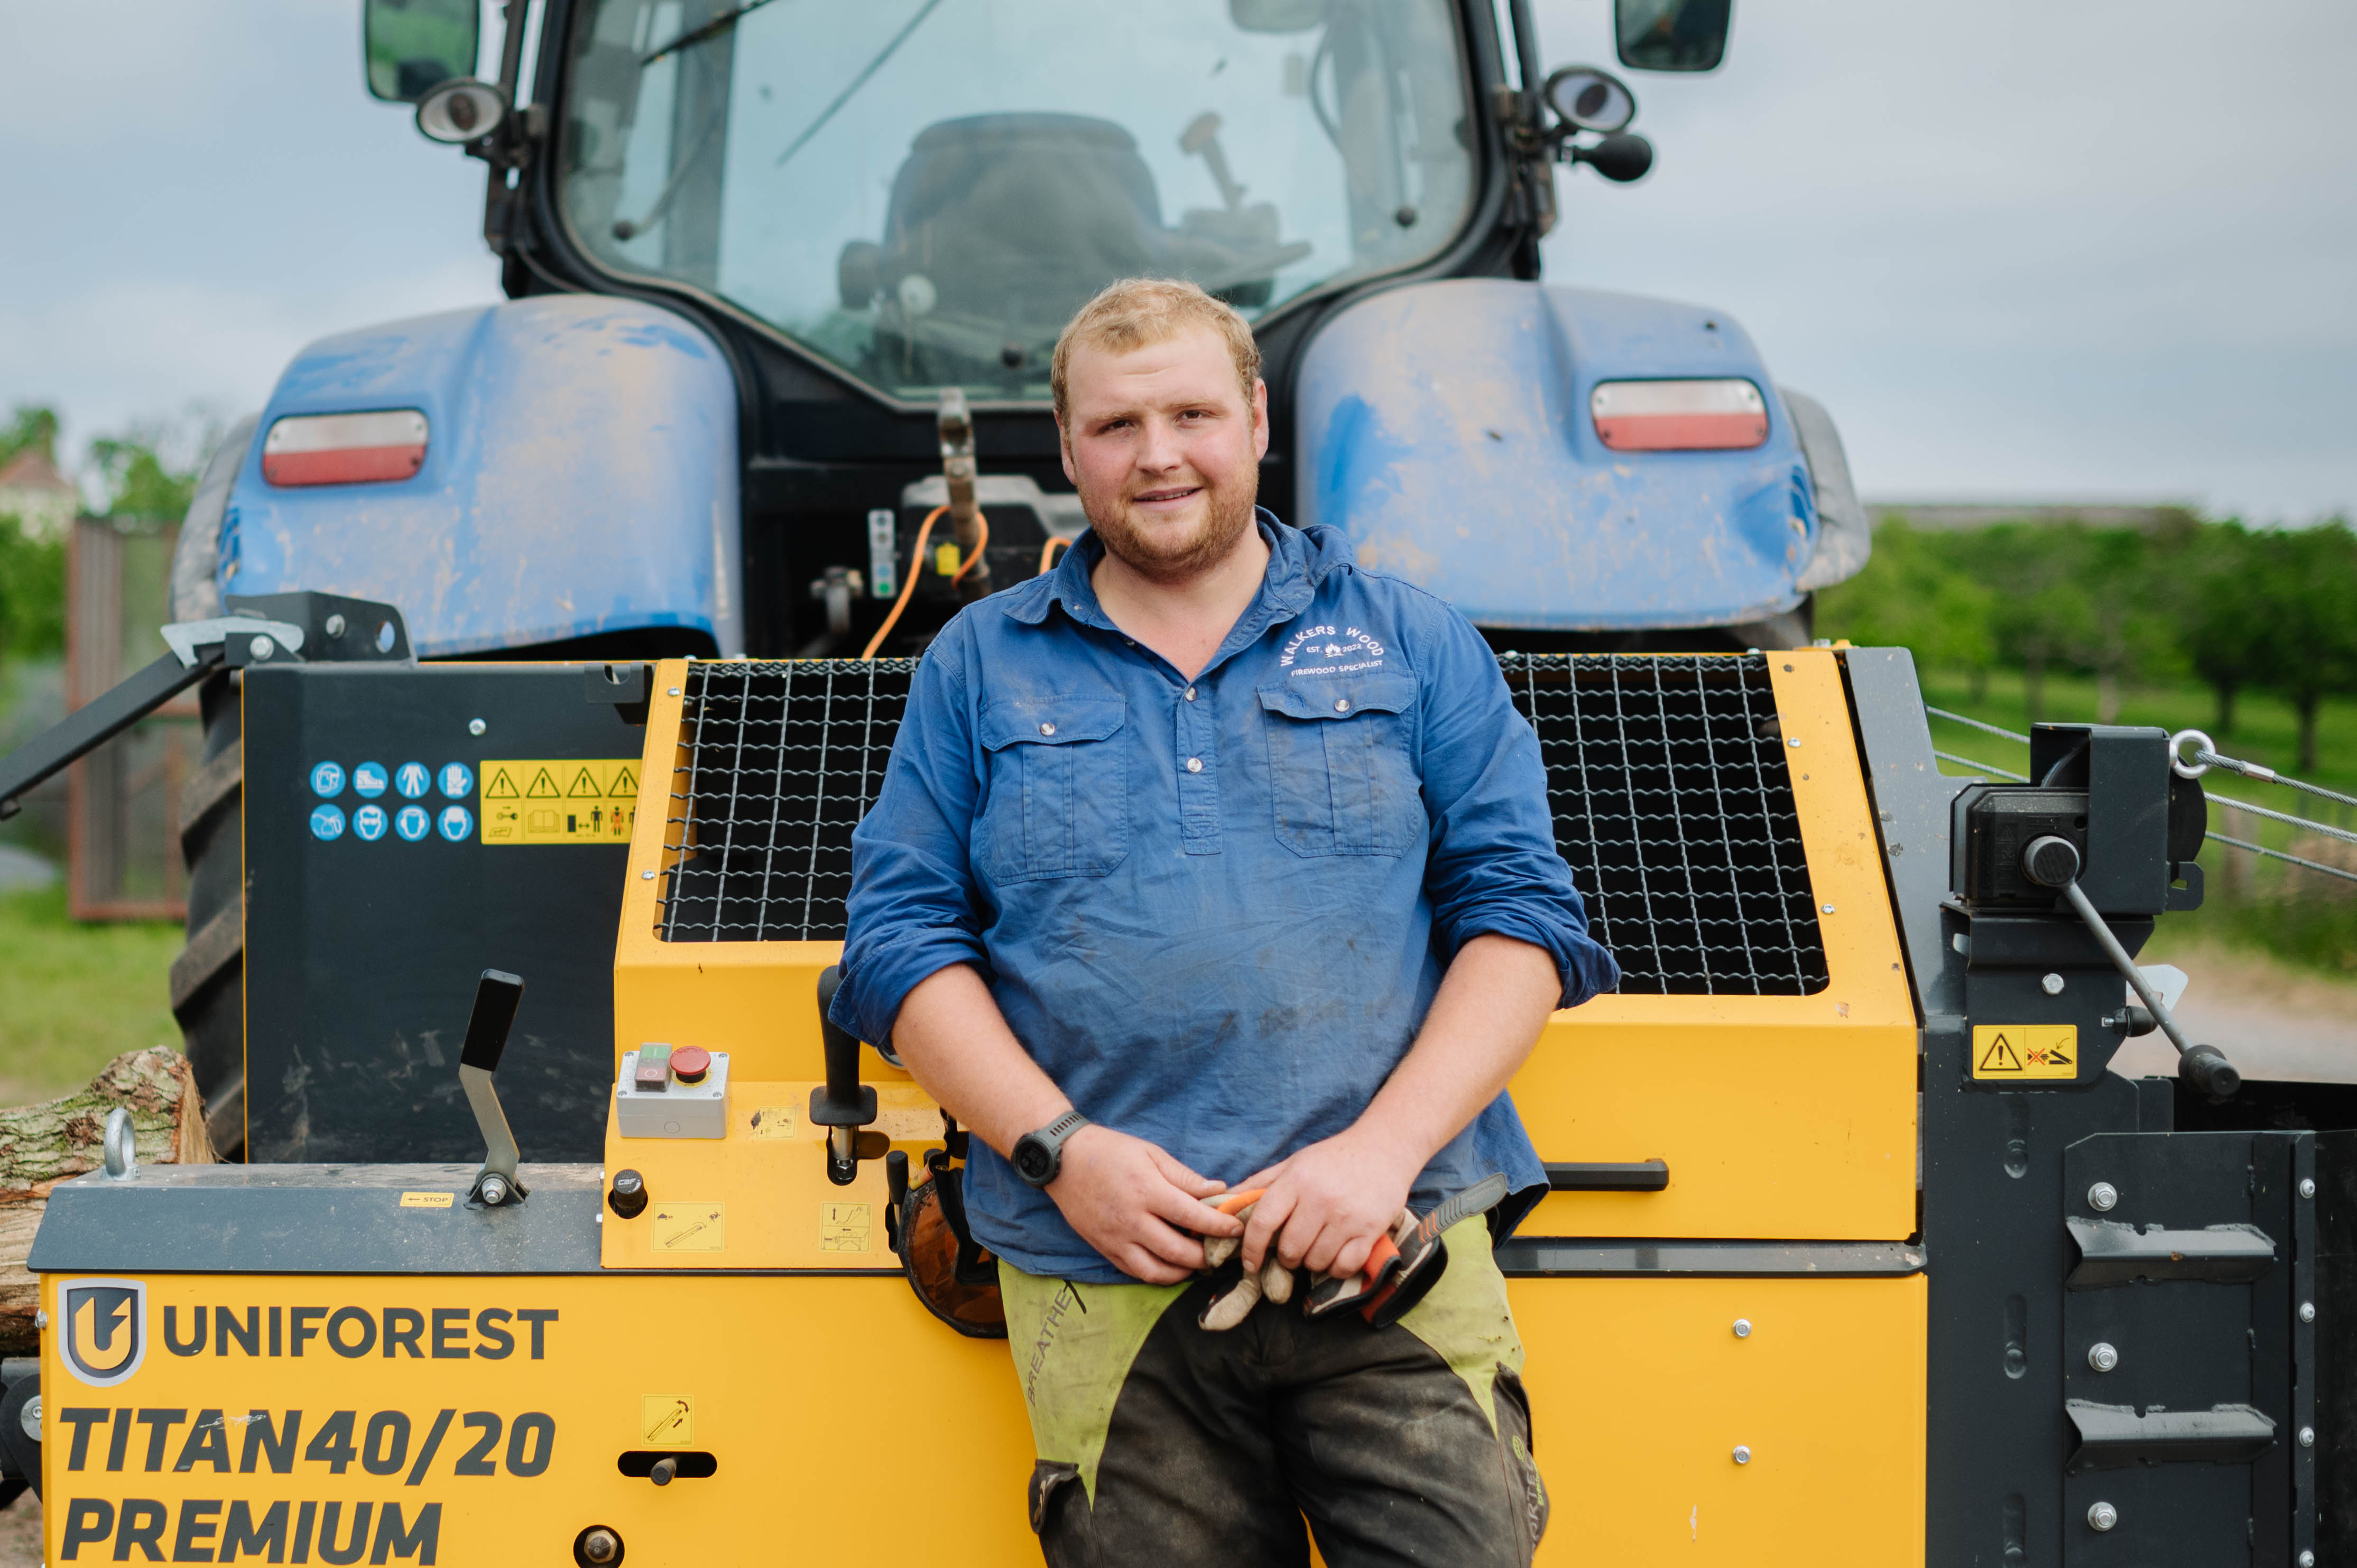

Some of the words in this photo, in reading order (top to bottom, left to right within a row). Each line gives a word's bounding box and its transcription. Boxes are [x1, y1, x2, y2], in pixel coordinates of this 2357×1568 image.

[1280, 626, 1336, 667] WALKERS
[1346, 627, 1384, 656] WOOD
[1342, 644, 1362, 652] 2022
[1291, 666, 1336, 677] FIREWOOD
[1338, 660, 1383, 672] SPECIALIST
[163, 1305, 559, 1360] UNIFOREST
[60, 1498, 442, 1566] PREMIUM
